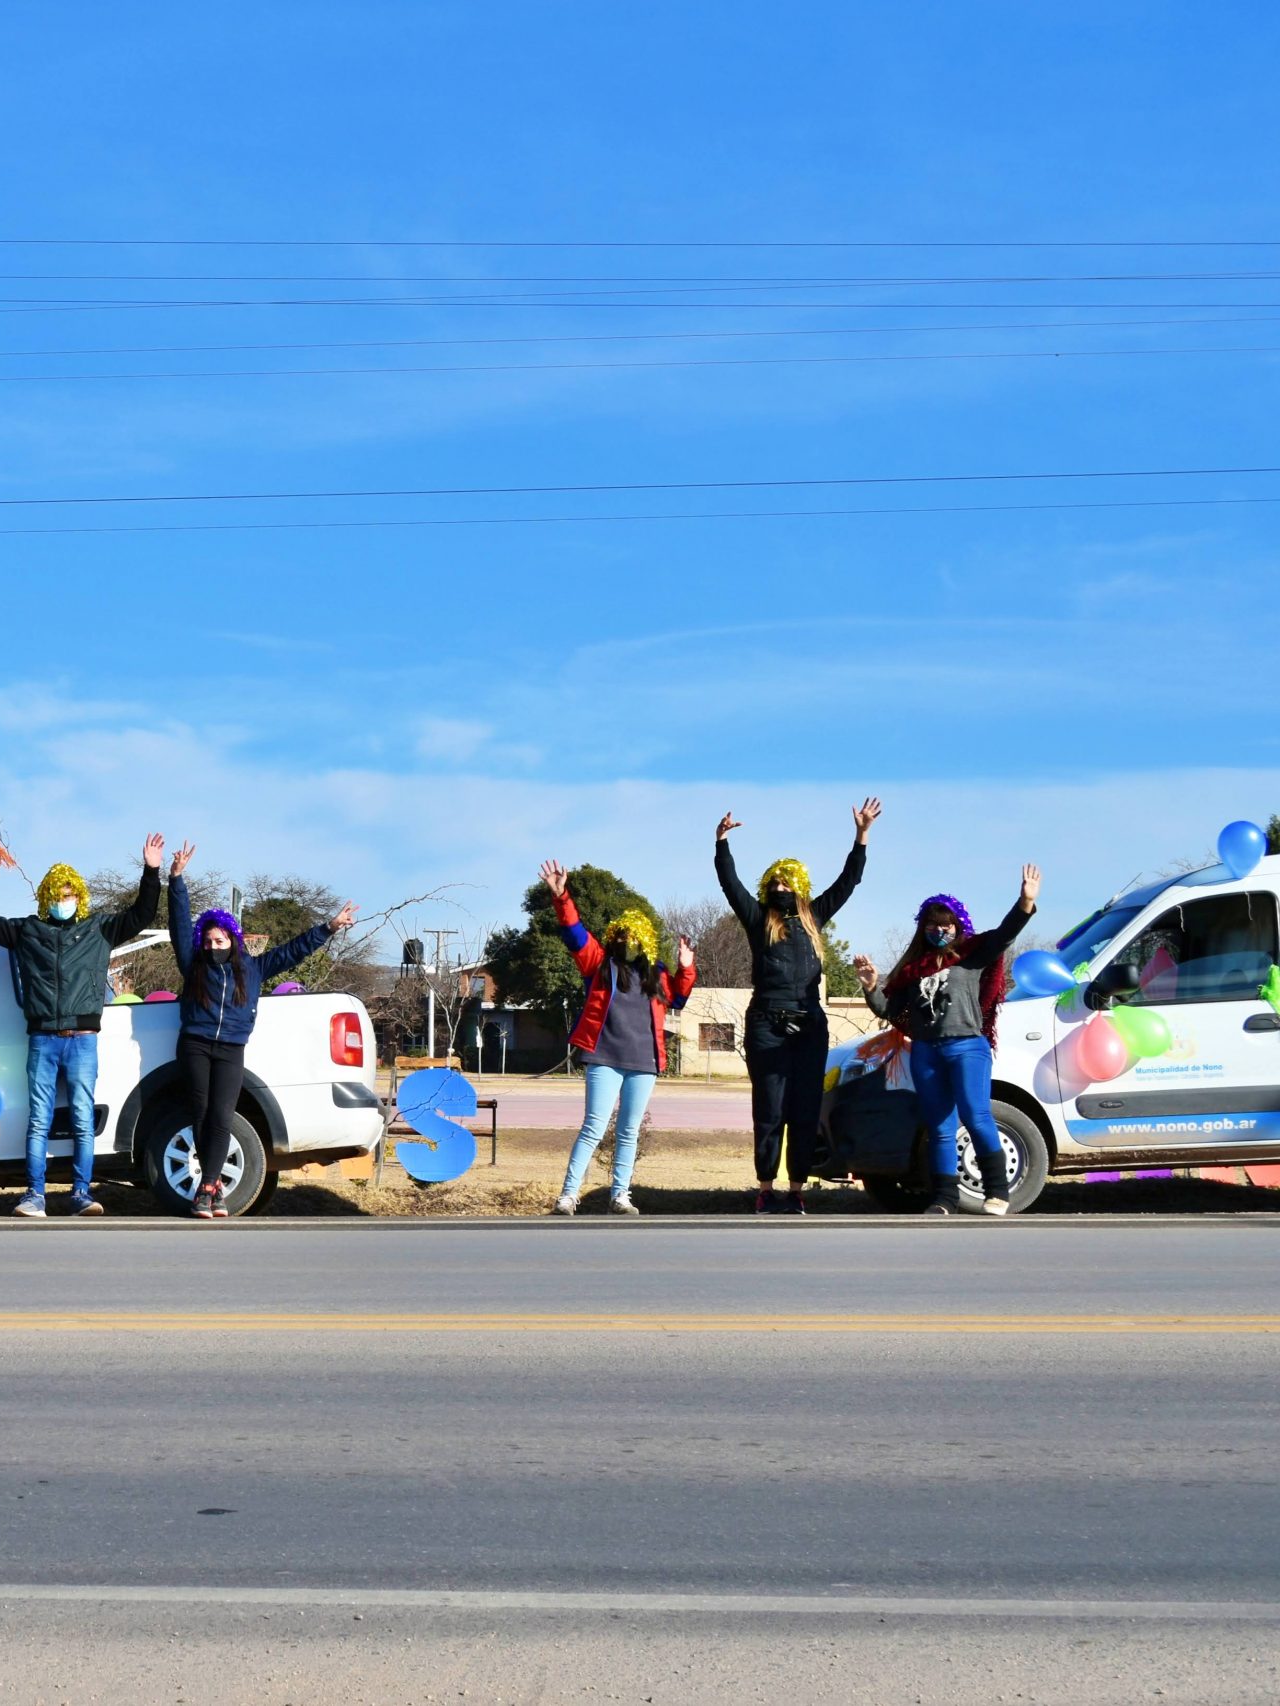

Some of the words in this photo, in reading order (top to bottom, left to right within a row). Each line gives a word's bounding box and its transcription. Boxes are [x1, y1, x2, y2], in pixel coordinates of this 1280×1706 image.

[1135, 1065, 1189, 1074] Municipalidad
[1191, 1063, 1201, 1072] de
[1202, 1062, 1223, 1071] Nono
[1107, 1118, 1257, 1134] www.nono.gob.ar
